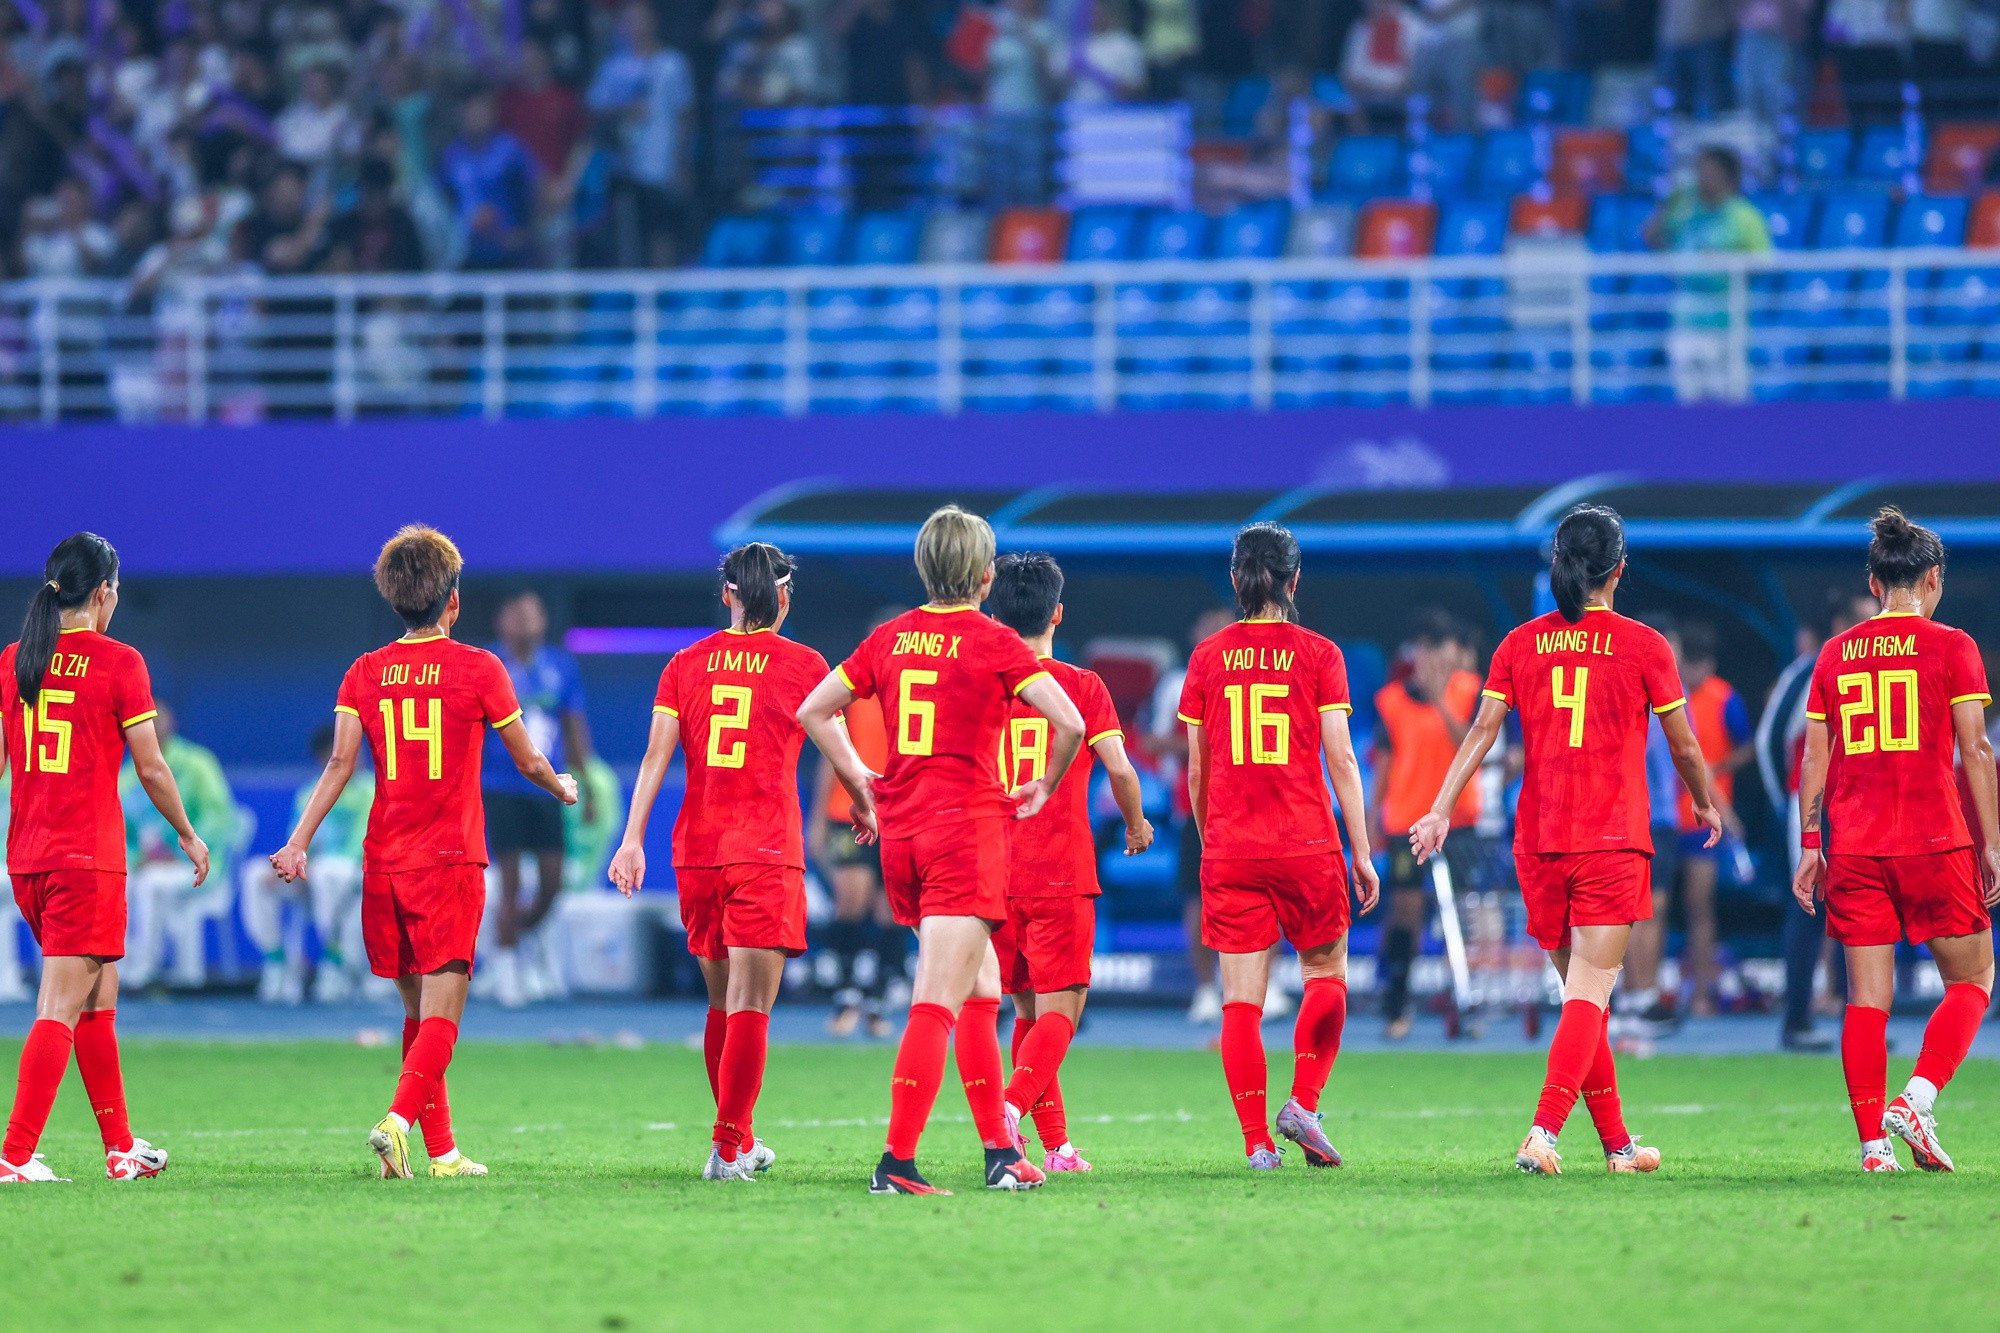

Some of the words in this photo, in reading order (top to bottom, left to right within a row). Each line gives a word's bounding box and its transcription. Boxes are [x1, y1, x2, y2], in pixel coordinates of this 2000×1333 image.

[380, 663, 410, 687] LOU
[414, 663, 441, 686] JH
[706, 650, 722, 673] LI
[891, 631, 945, 657] ZHANG
[945, 635, 962, 659] X
[1222, 647, 1255, 672] YAO
[1535, 629, 1588, 655] WANG
[1592, 631, 1614, 656] LL
[1842, 637, 1870, 662] WU
[1872, 634, 1919, 657] RGML
[19, 688, 76, 774] 15
[378, 697, 442, 781] 14
[706, 684, 753, 769] 2
[897, 668, 939, 756] 6
[1223, 683, 1290, 766] 16
[1551, 665, 1589, 748] 4
[1834, 669, 1920, 756] 20
[997, 717, 1049, 796] 18
[1235, 1089, 1265, 1101] CFA
